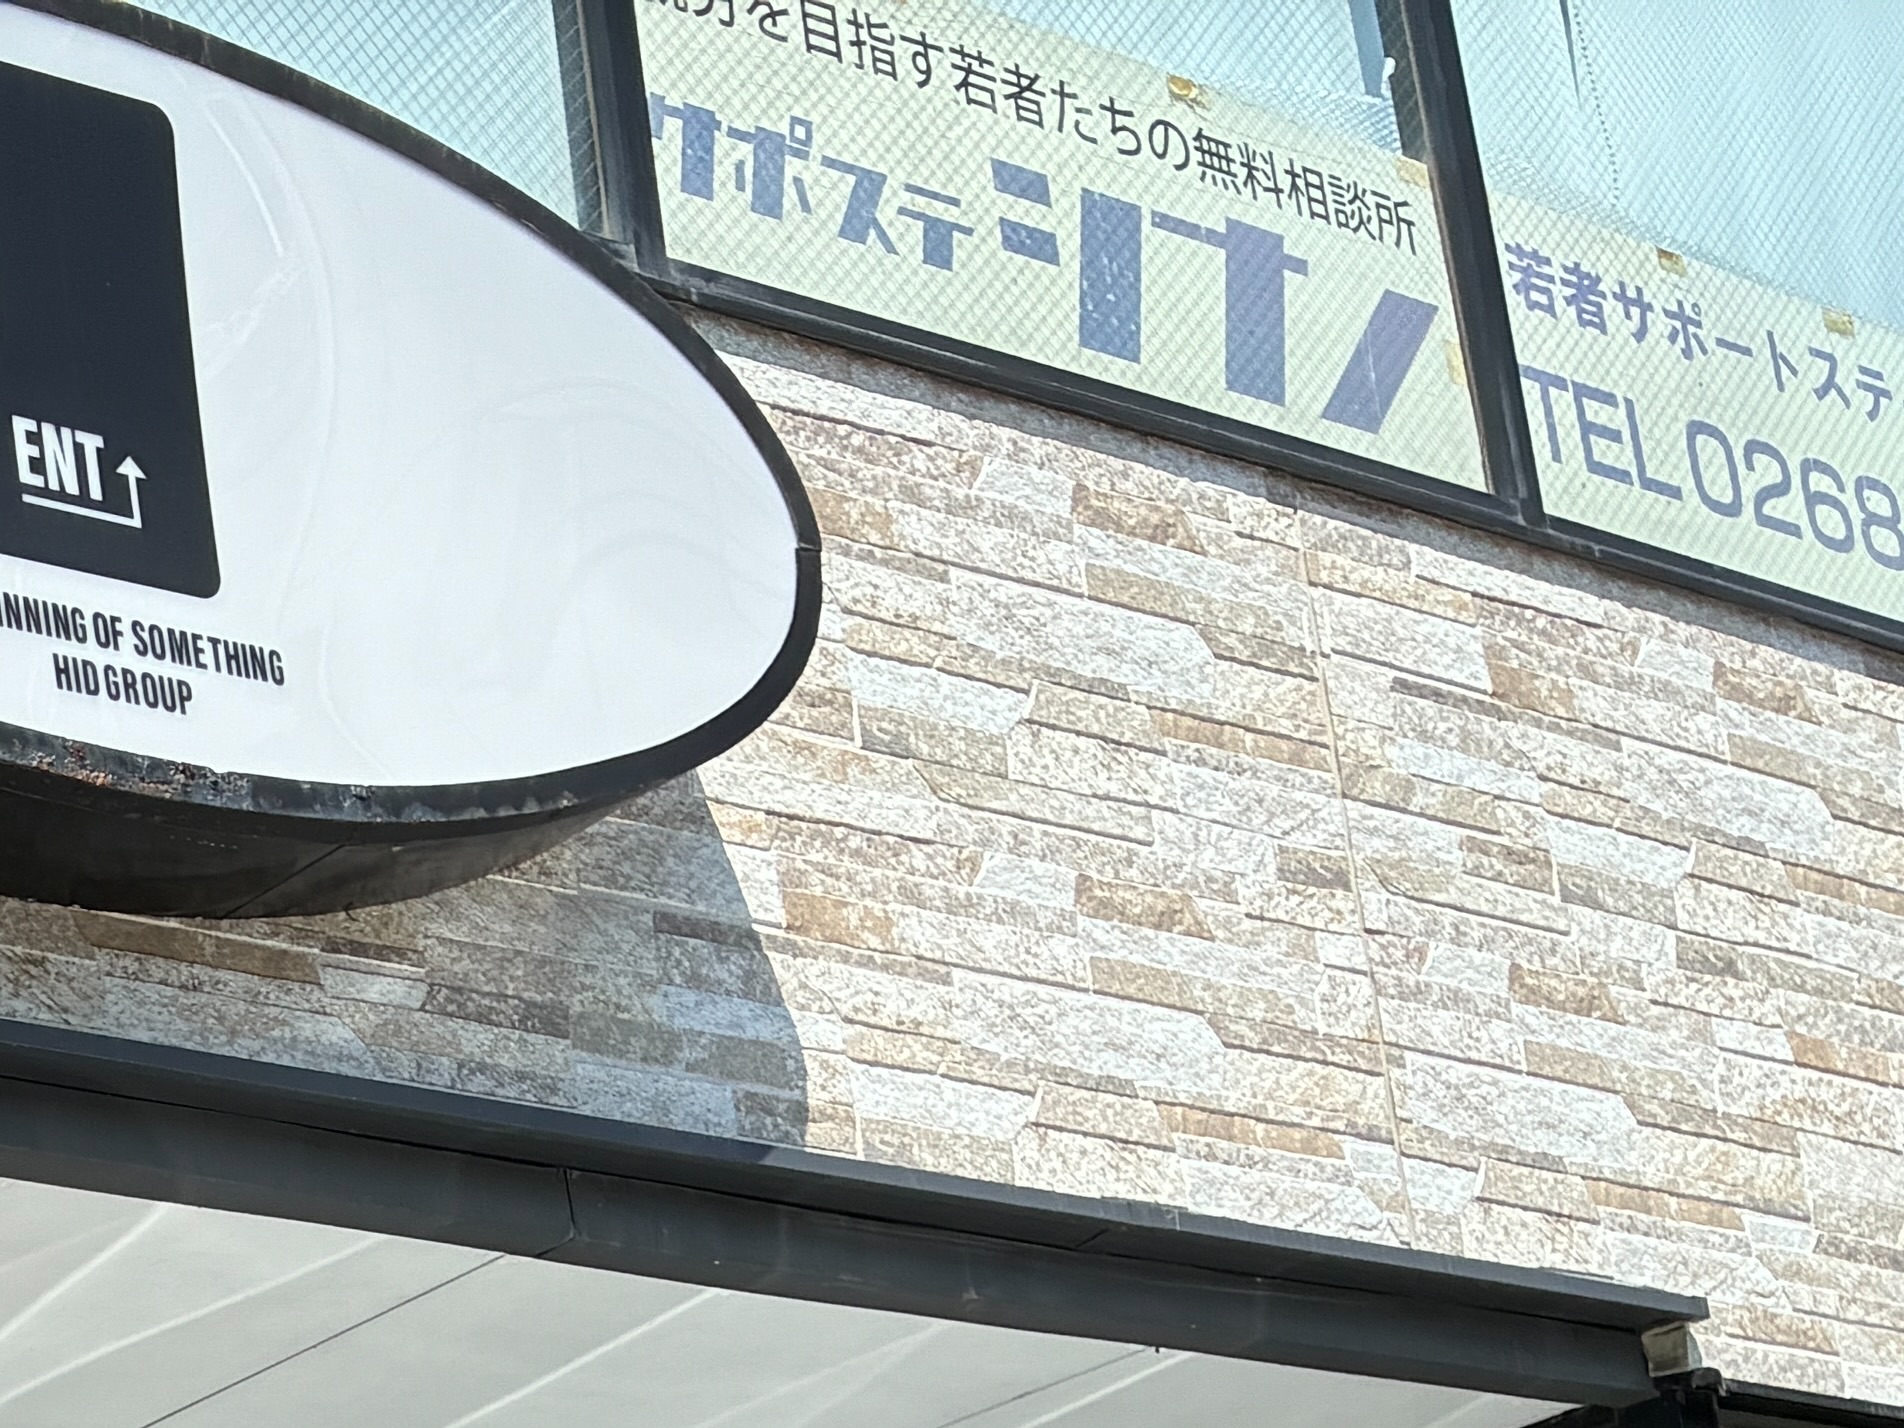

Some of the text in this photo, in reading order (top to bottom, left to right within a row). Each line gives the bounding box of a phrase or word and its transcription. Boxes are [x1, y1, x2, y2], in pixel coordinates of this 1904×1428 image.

[658, 0, 1416, 254] を目指す若者たちの無料相談所
[1505, 242, 1893, 423] 若者サポートステ
[12, 414, 105, 502] ENT
[52, 653, 192, 716] HID GROUP
[92, 611, 124, 652] OF
[131, 619, 285, 686] SOMETHING
